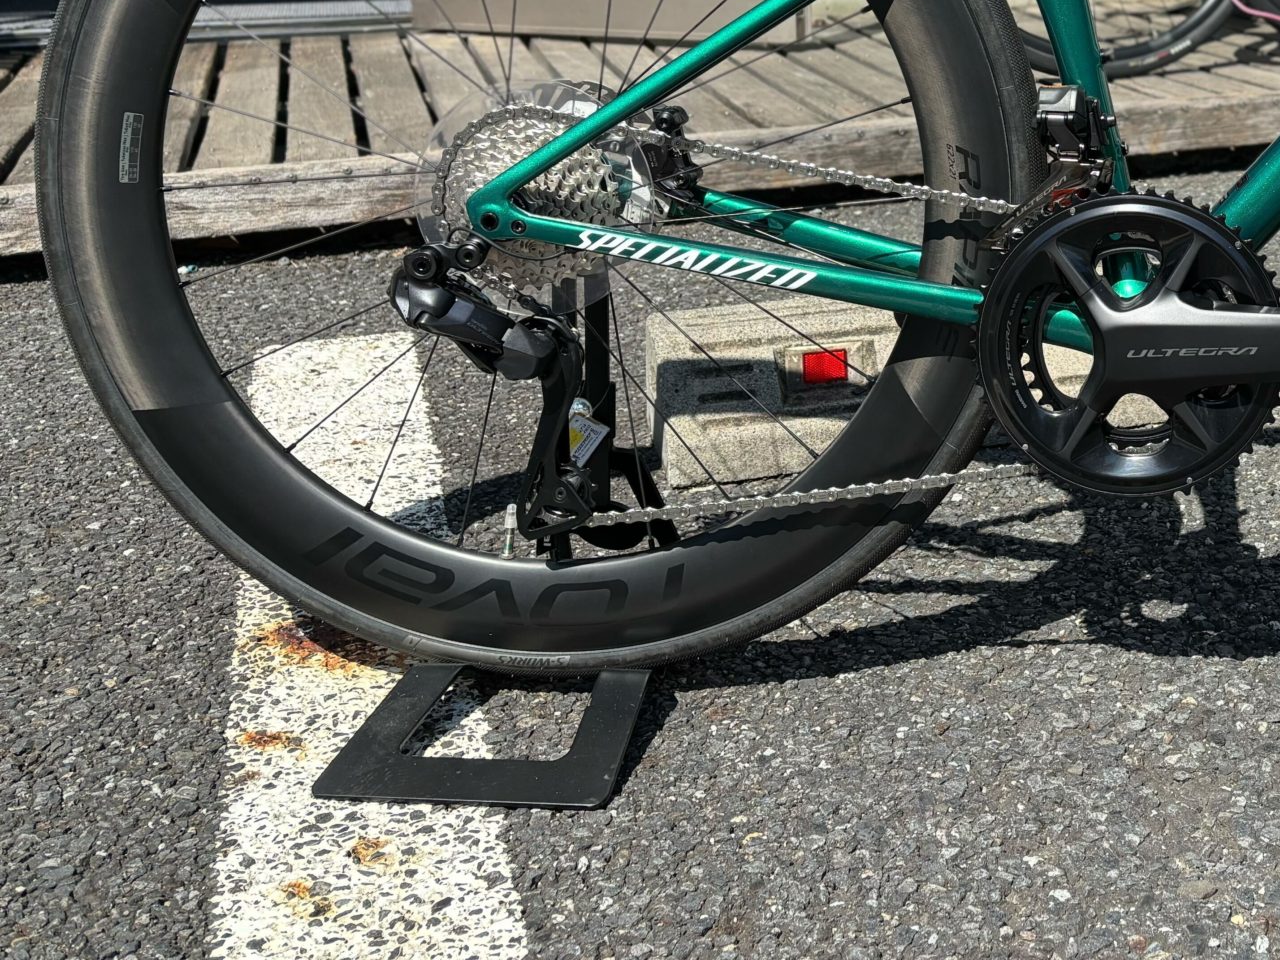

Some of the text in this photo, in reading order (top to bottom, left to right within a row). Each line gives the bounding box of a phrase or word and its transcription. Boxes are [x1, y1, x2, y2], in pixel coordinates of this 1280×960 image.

[1016, 175, 1067, 217] ULTEGRA
[565, 229, 818, 290] SPECIALIZED
[1126, 346, 1259, 359] ULTEGRA
[304, 526, 685, 626] roval
[497, 655, 566, 667] S-WORKS
